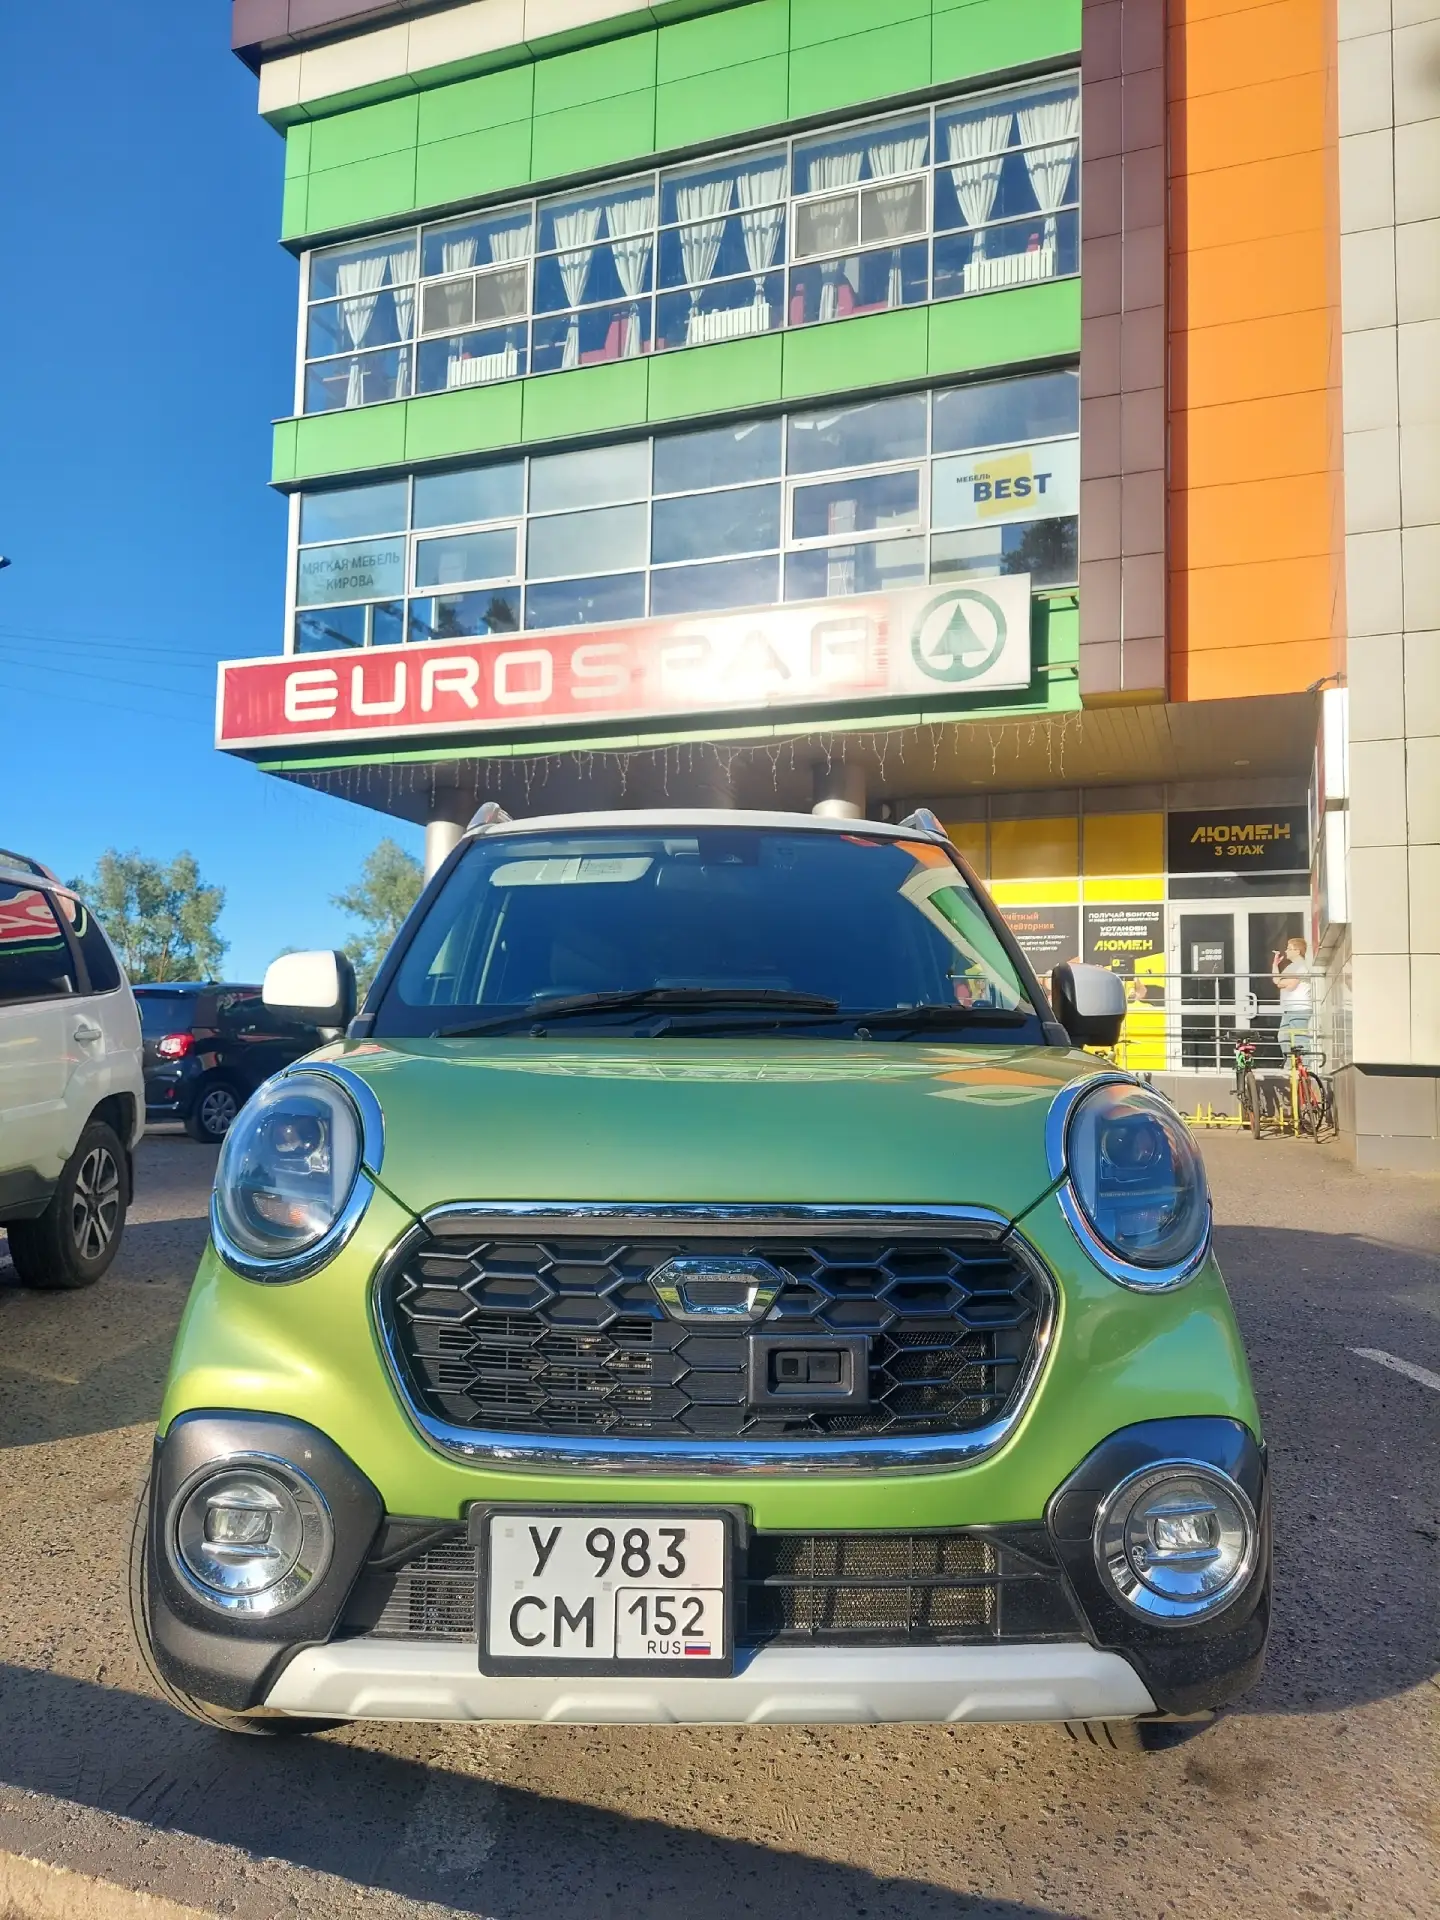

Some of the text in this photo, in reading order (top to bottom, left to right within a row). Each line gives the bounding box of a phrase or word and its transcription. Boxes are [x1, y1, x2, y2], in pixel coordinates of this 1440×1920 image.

[956, 473, 991, 484] МЕБЕЛЬ
[973, 473, 1052, 503] BEST
[302, 551, 400, 575] МЯГКАЯ МЕБЕЛЬ
[326, 574, 374, 591] КИРОВА
[1190, 823, 1291, 843] ЛЮМЕН
[1214, 844, 1264, 856] 3 ЭТАЖ
[1088, 911, 1125, 919] ПОЛУЧАЙ
[1093, 939, 1153, 951] ЛЮМЕН
[528, 1526, 686, 1578] У 983
[509, 1595, 704, 1648] СМ 152
[647, 1640, 681, 1654] RUS
